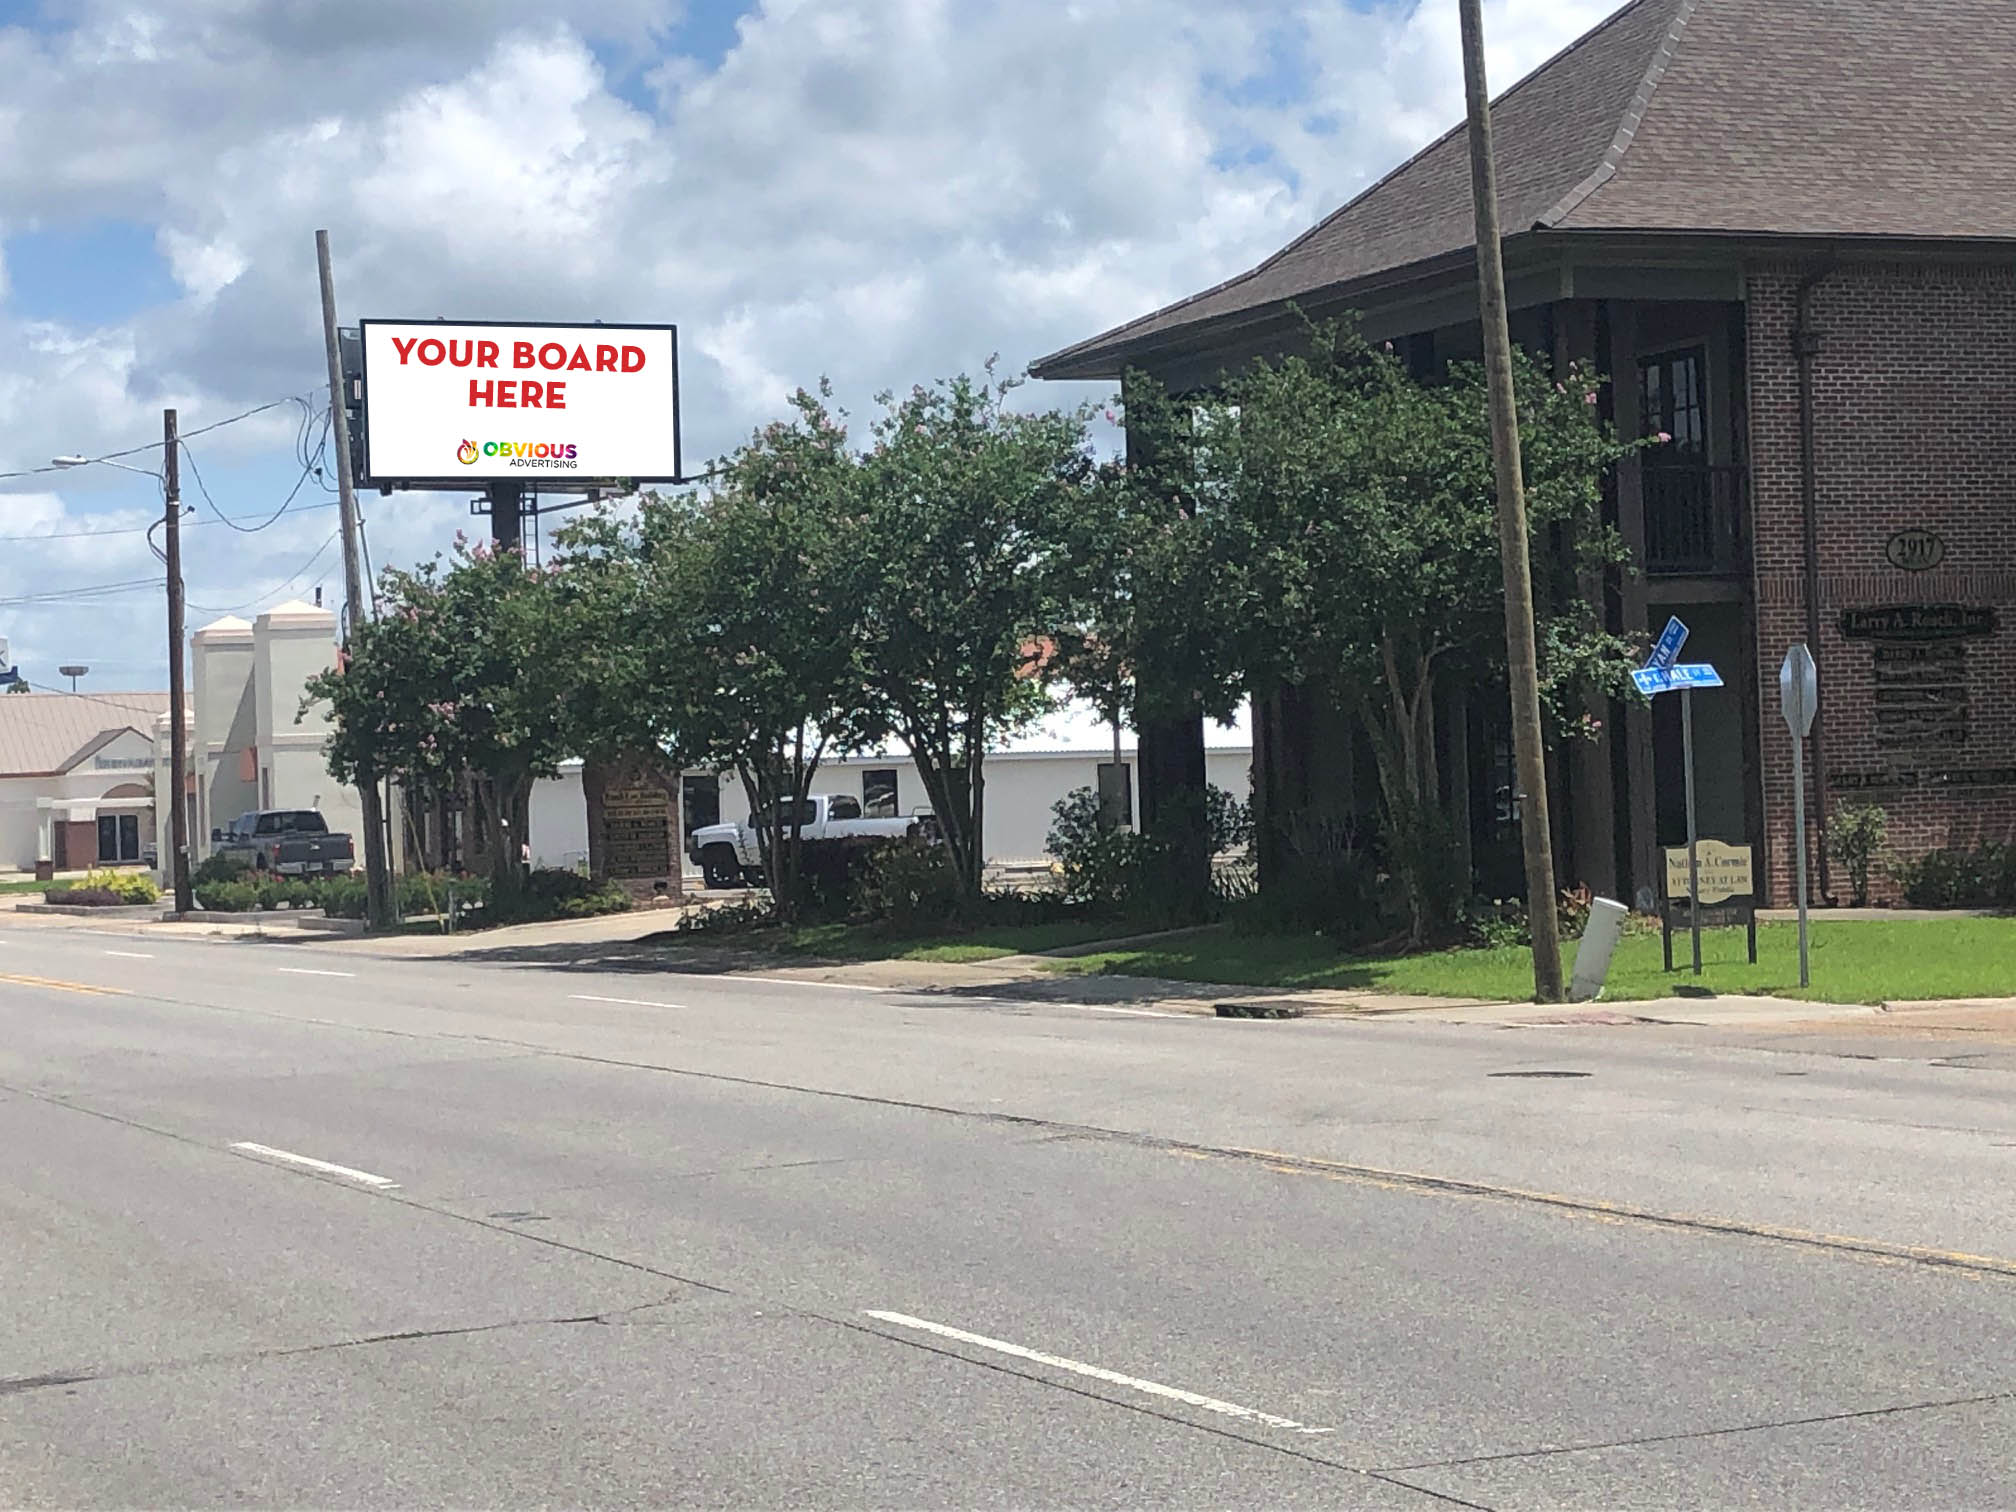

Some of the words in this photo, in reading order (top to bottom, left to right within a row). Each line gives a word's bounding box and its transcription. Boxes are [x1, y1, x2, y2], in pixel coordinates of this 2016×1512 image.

[391, 337, 500, 369] YOUR
[512, 341, 646, 373] BOARD
[468, 379, 567, 409] HERE
[483, 441, 578, 459] OBVIOUS
[509, 458, 578, 469] ADVERTISING
[1898, 536, 1936, 560] 2917
[1850, 613, 1888, 632] Larry
